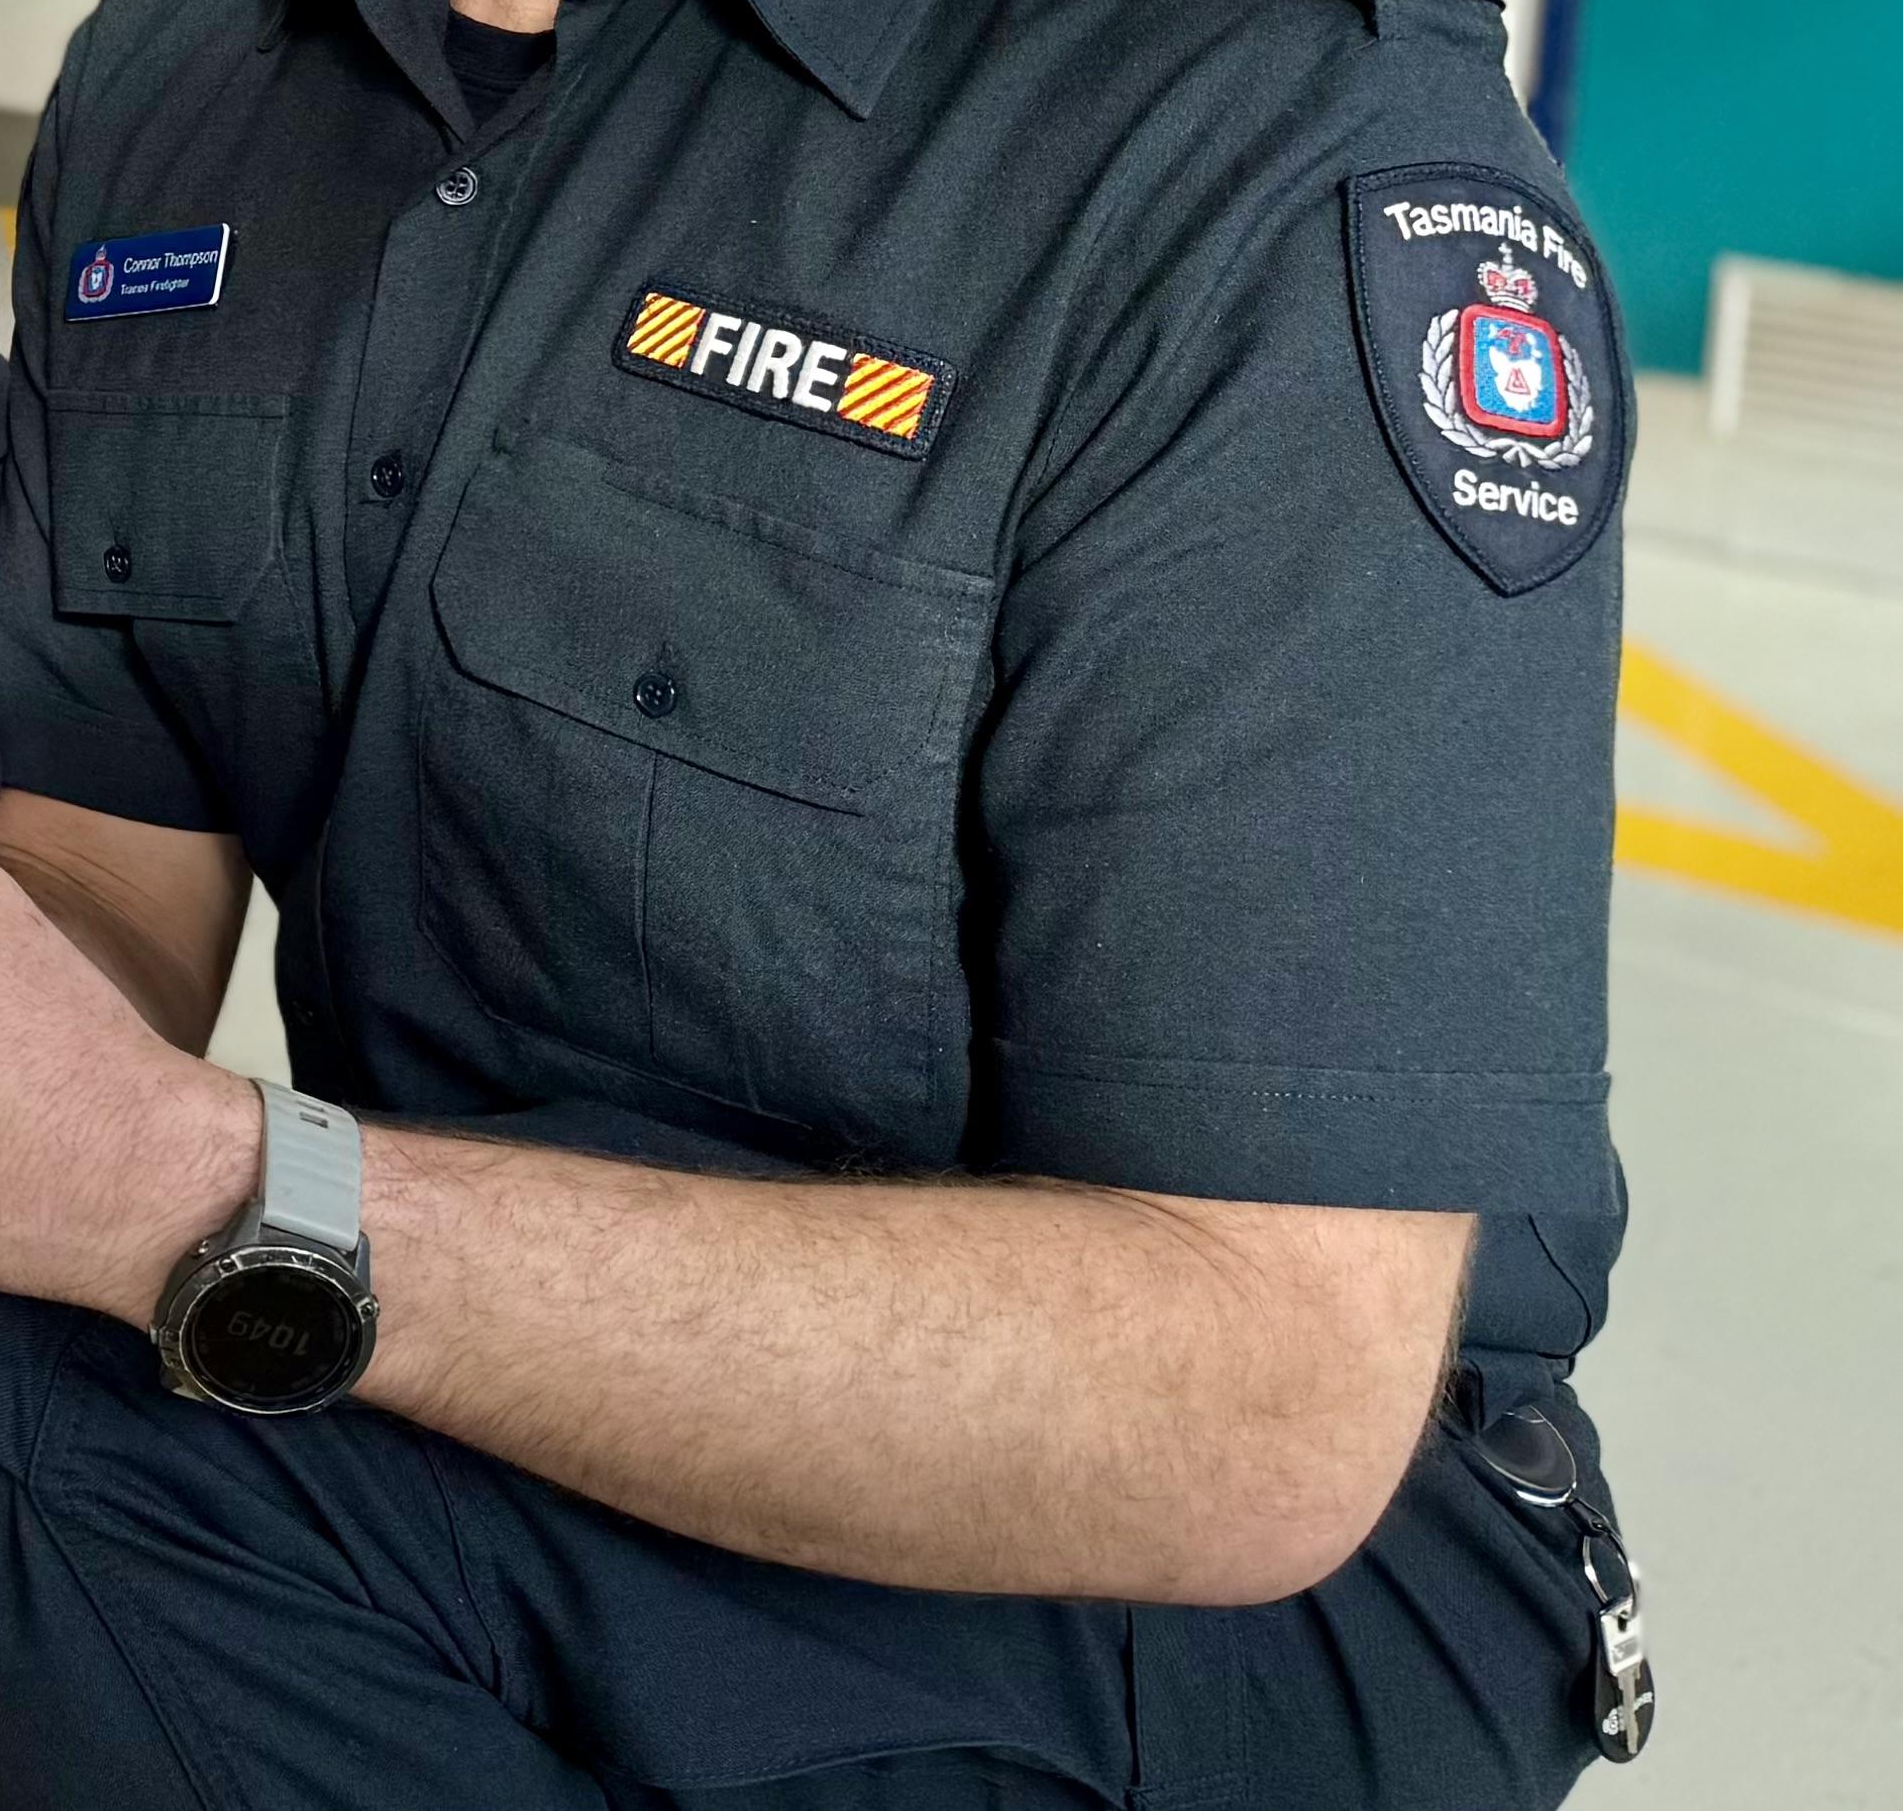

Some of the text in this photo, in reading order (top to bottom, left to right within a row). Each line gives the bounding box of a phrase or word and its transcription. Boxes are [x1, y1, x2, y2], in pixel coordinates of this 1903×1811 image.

[123, 250, 218, 274] Connor Thompson
[1382, 200, 1590, 291] Tasmania Fire
[690, 311, 848, 414] FIRE
[1452, 467, 1581, 527] Service
